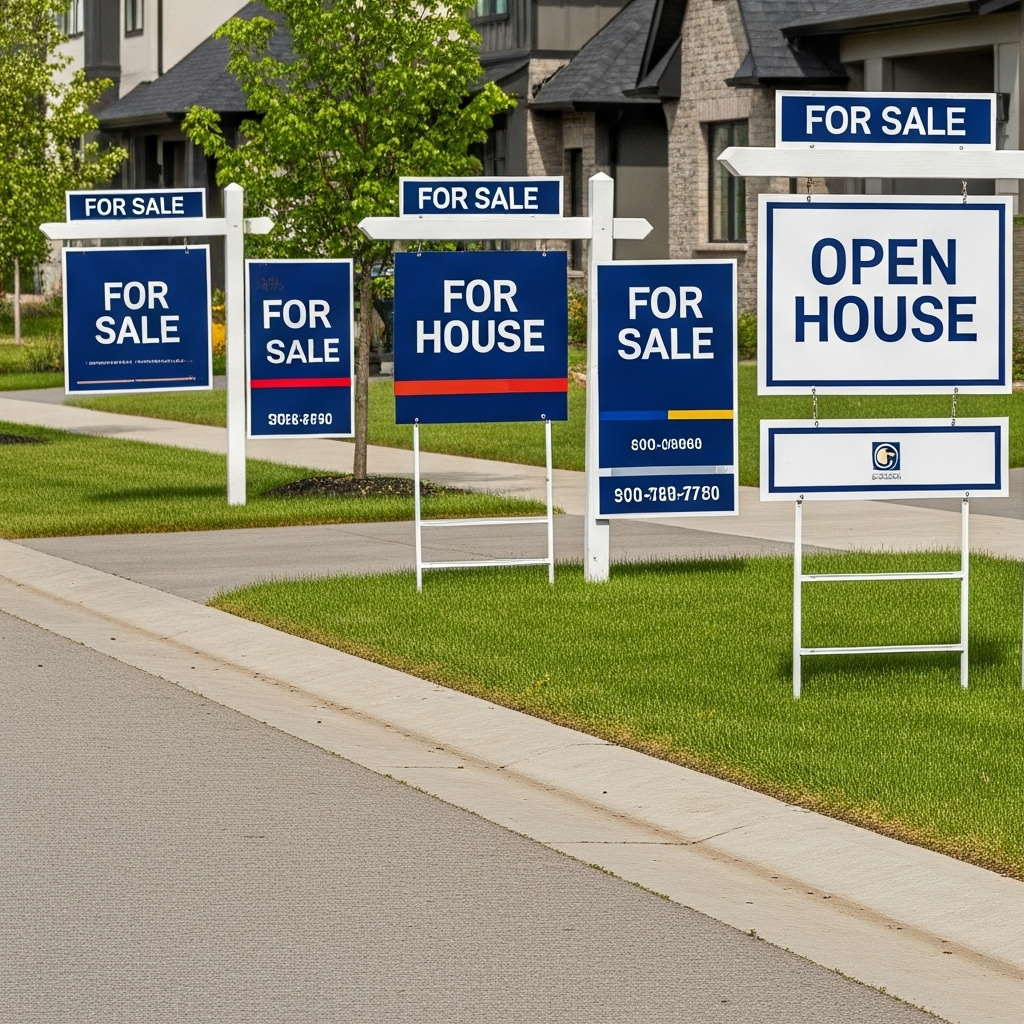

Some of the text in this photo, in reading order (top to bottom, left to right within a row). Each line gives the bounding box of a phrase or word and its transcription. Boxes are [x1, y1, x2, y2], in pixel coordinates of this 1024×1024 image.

[807, 105, 965, 135] FOR SALE
[85, 196, 184, 216] FOR SALE
[419, 187, 538, 210] FOR SALE
[812, 238, 956, 285] OPEN
[104, 281, 169, 310] FOR
[444, 279, 518, 313] FOR
[629, 286, 703, 319] FOR
[95, 315, 180, 344] SALE
[263, 300, 331, 329] FOR
[795, 296, 977, 342] HOUSE
[267, 338, 339, 364] SALE
[417, 320, 544, 353] HOUSE
[618, 327, 714, 359] SALE
